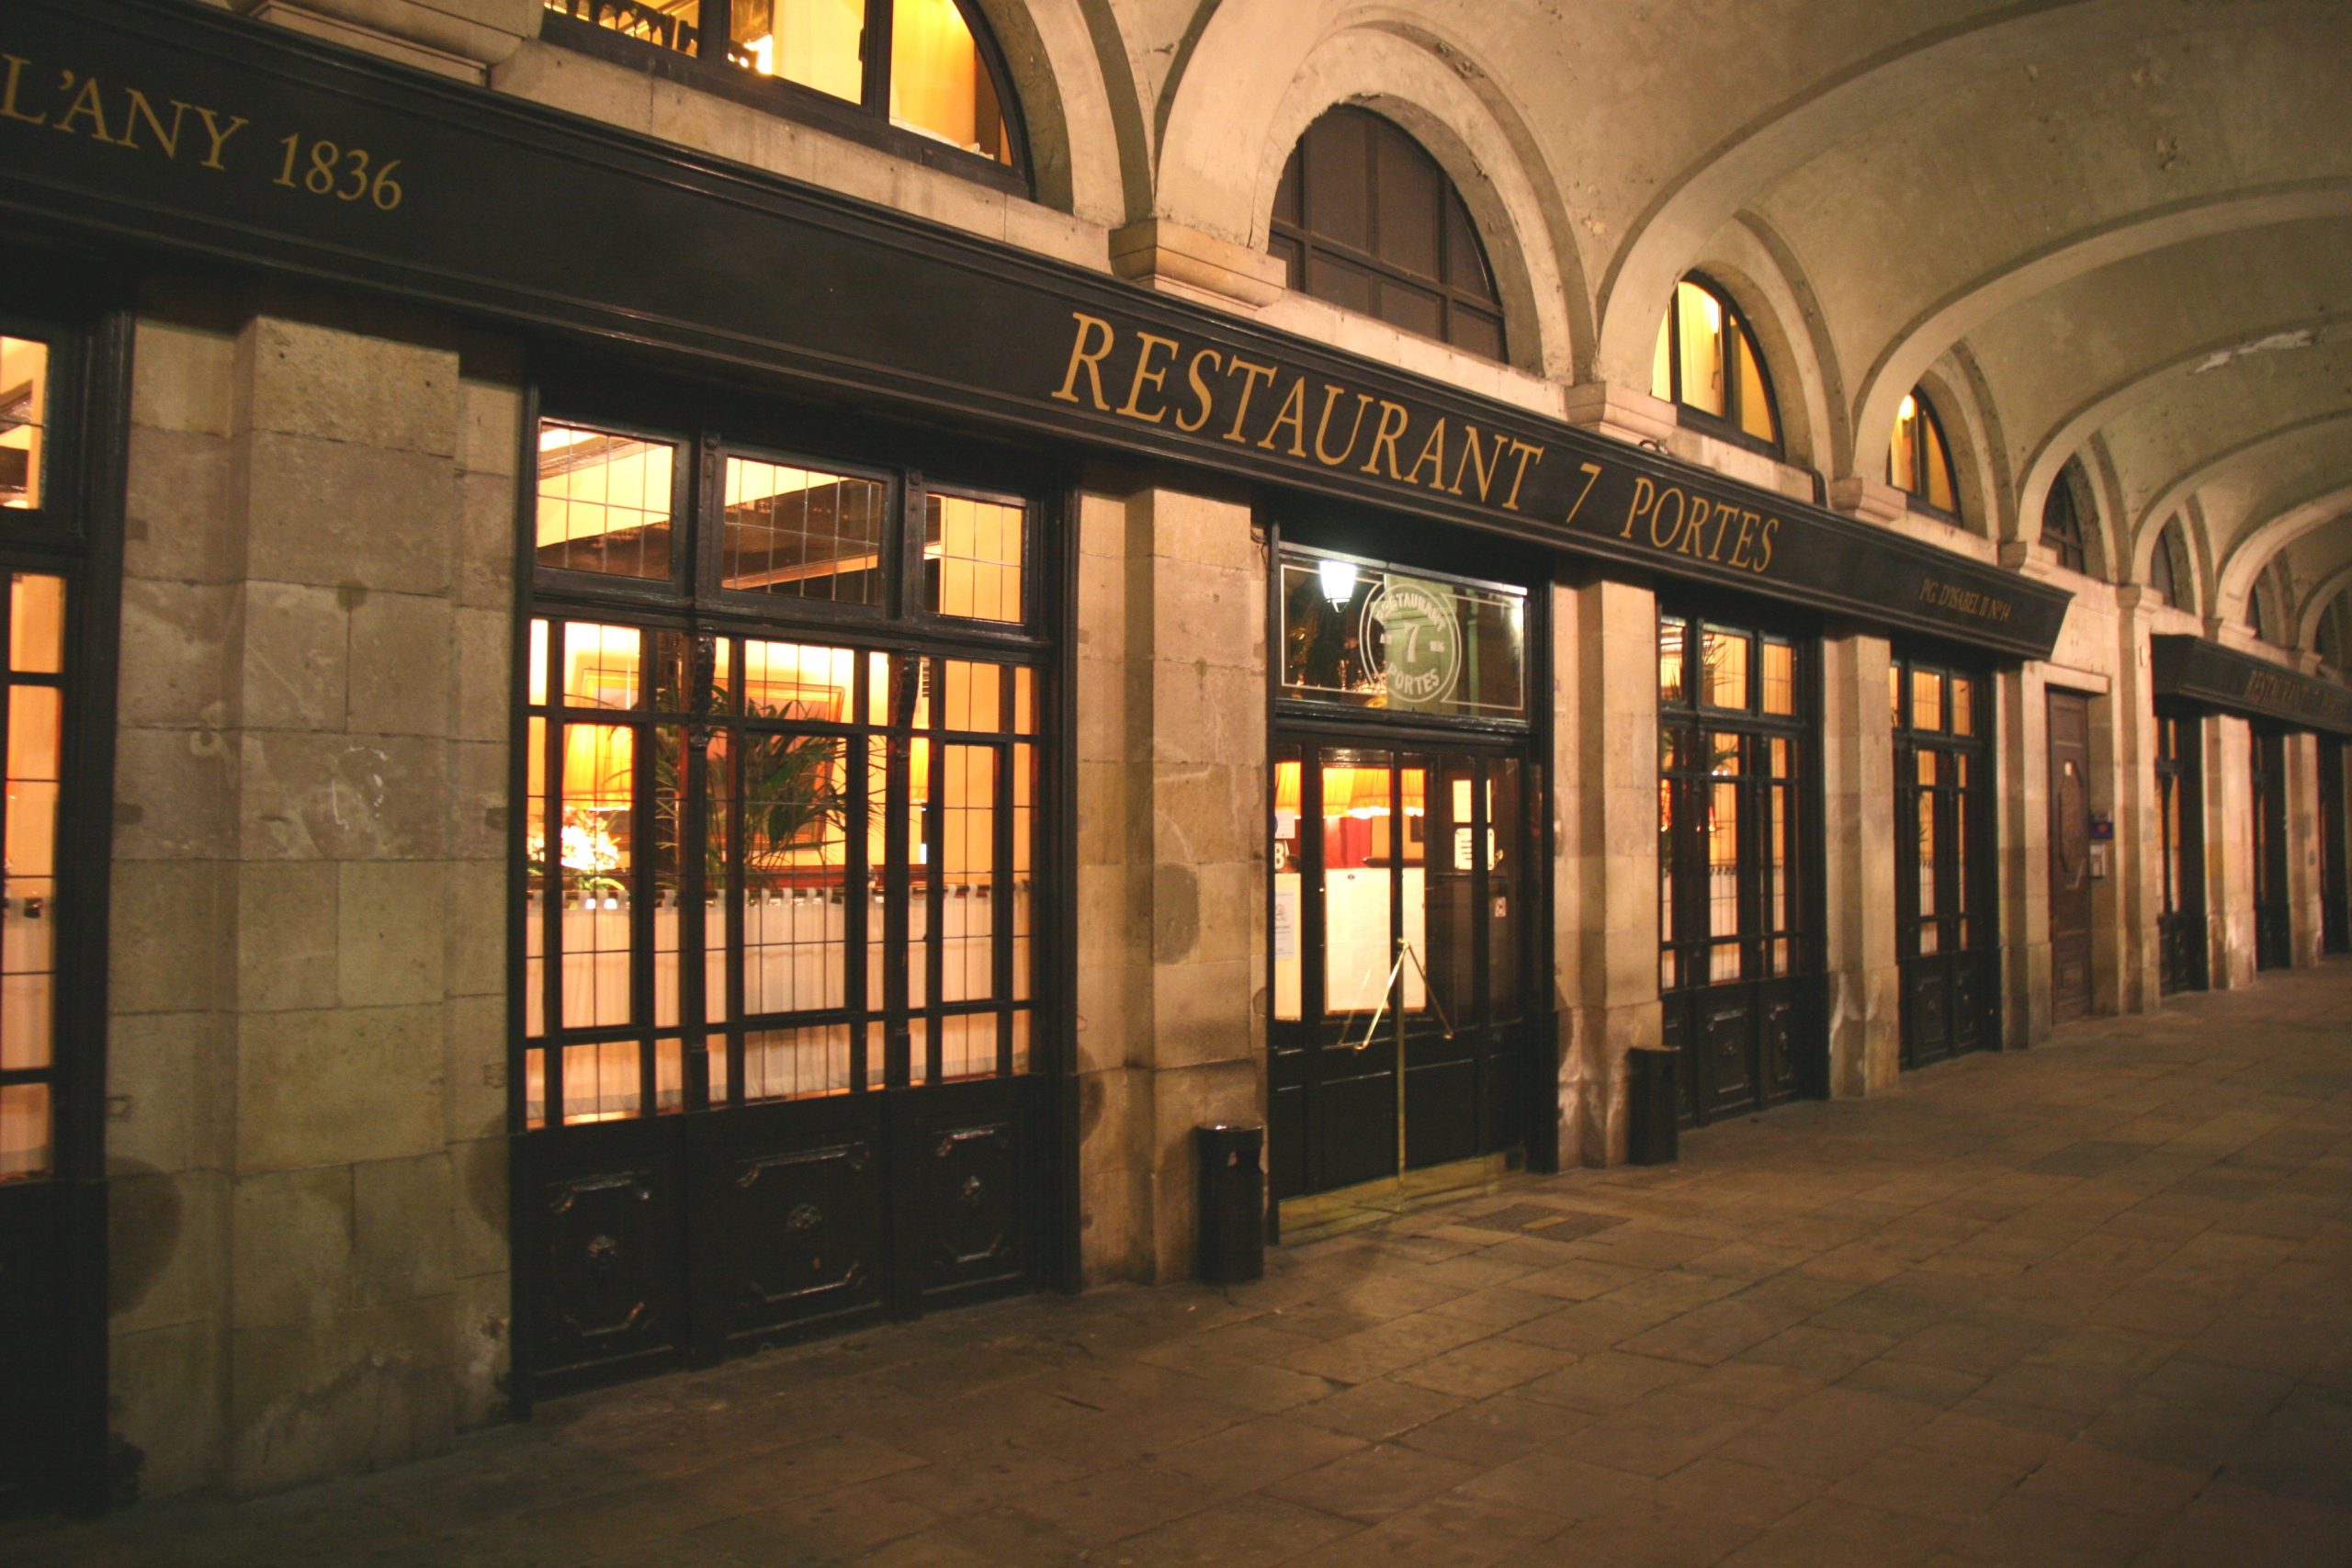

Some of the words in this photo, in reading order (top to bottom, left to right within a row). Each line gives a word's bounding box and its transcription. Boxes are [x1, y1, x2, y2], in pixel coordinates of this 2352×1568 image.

[272, 132, 402, 210] 1836
[1051, 311, 1544, 512] RESTAURANT
[1566, 462, 1602, 524] 7
[1620, 477, 1780, 573] PORTES
[1377, 592, 1447, 632] RESTAURANT
[1404, 622, 1420, 662] 7
[1388, 661, 1440, 695] PORTES
